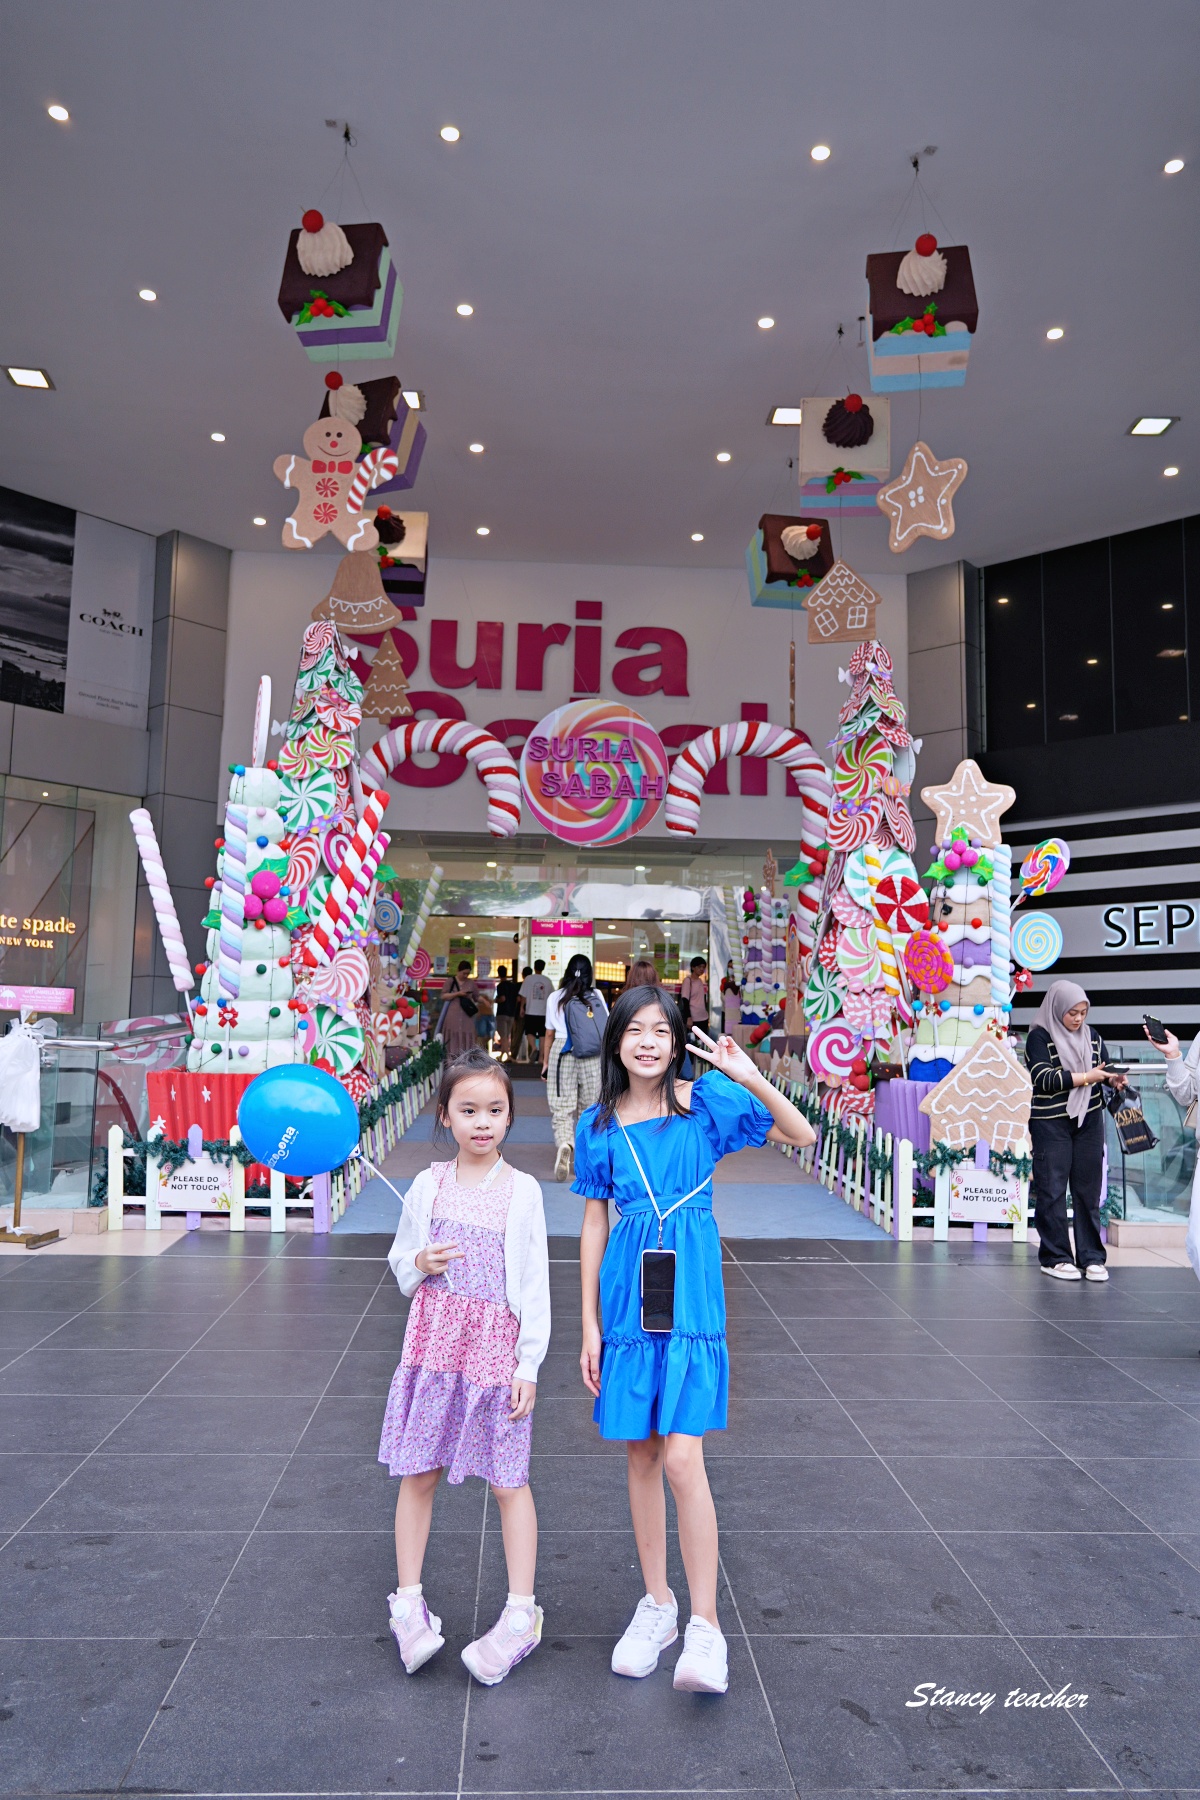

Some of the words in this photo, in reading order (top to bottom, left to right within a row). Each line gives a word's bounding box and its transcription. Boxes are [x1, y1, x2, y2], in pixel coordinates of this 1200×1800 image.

[79, 613, 143, 636] COACH
[345, 600, 690, 698] Suria
[527, 736, 639, 763] SURIA
[540, 772, 665, 800] SABAH
[22, 916, 76, 935] spade
[1103, 903, 1195, 948] SEP
[0, 936, 22, 946] NEW
[25, 937, 54, 949] YORK
[173, 1175, 205, 1183] PLEASE
[964, 1187, 994, 1195] PLEASE
